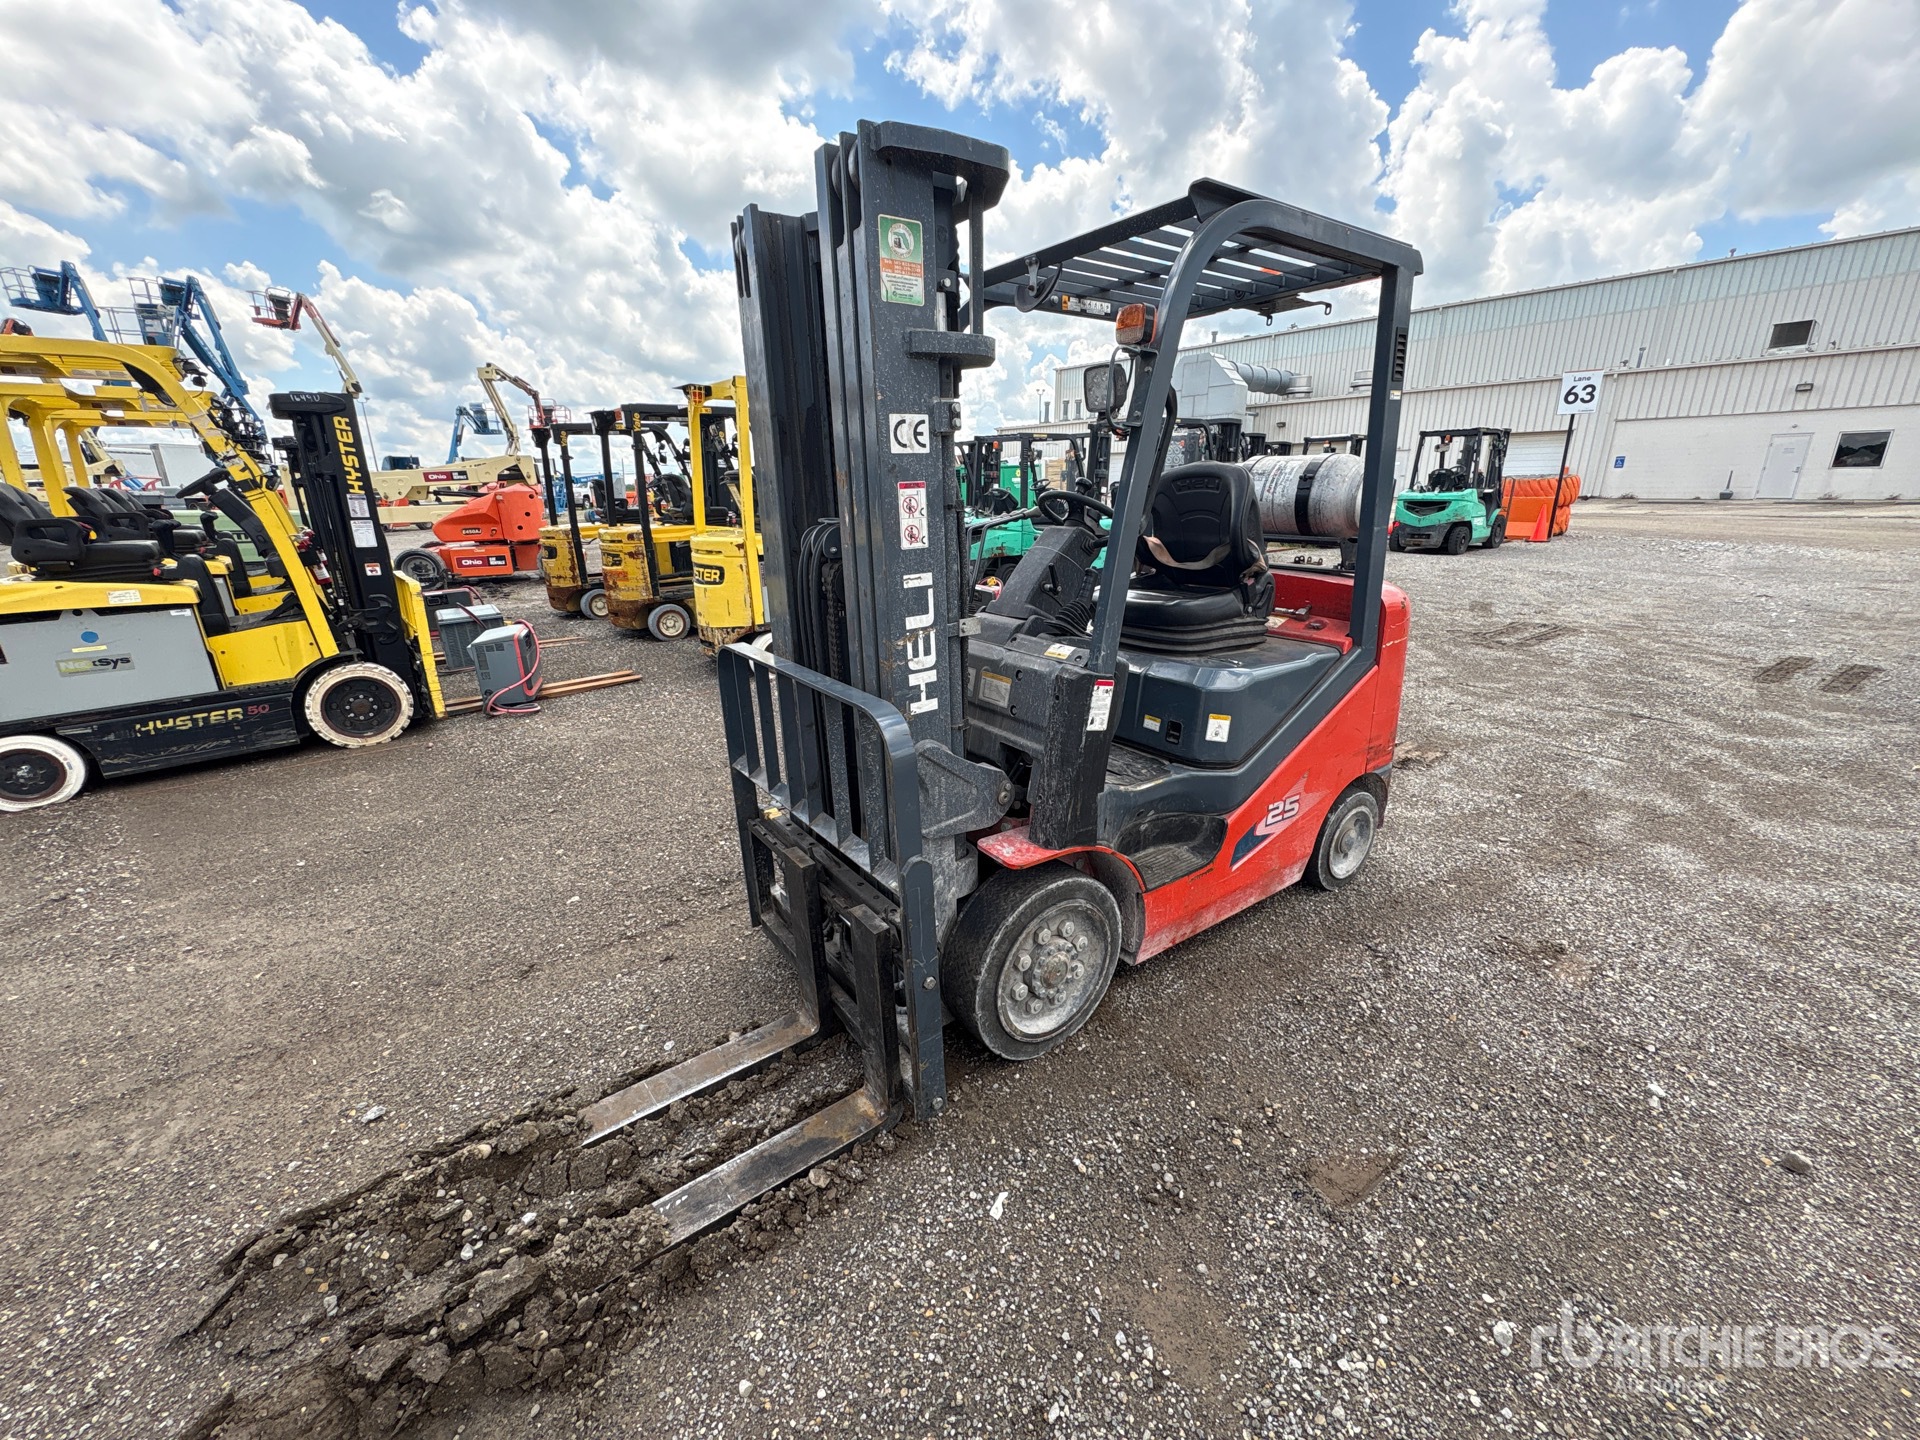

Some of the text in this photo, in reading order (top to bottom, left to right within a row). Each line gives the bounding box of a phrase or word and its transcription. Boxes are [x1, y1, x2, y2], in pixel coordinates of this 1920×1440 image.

[1563, 384, 1596, 405] 63
[632, 412, 641, 432] Yale
[559, 430, 567, 447] Yale
[333, 416, 366, 494] HYSTER
[693, 567, 720, 582] STER
[903, 572, 938, 715] HELI
[135, 704, 270, 737] HYSTER 50
[1265, 794, 1301, 827] 25
